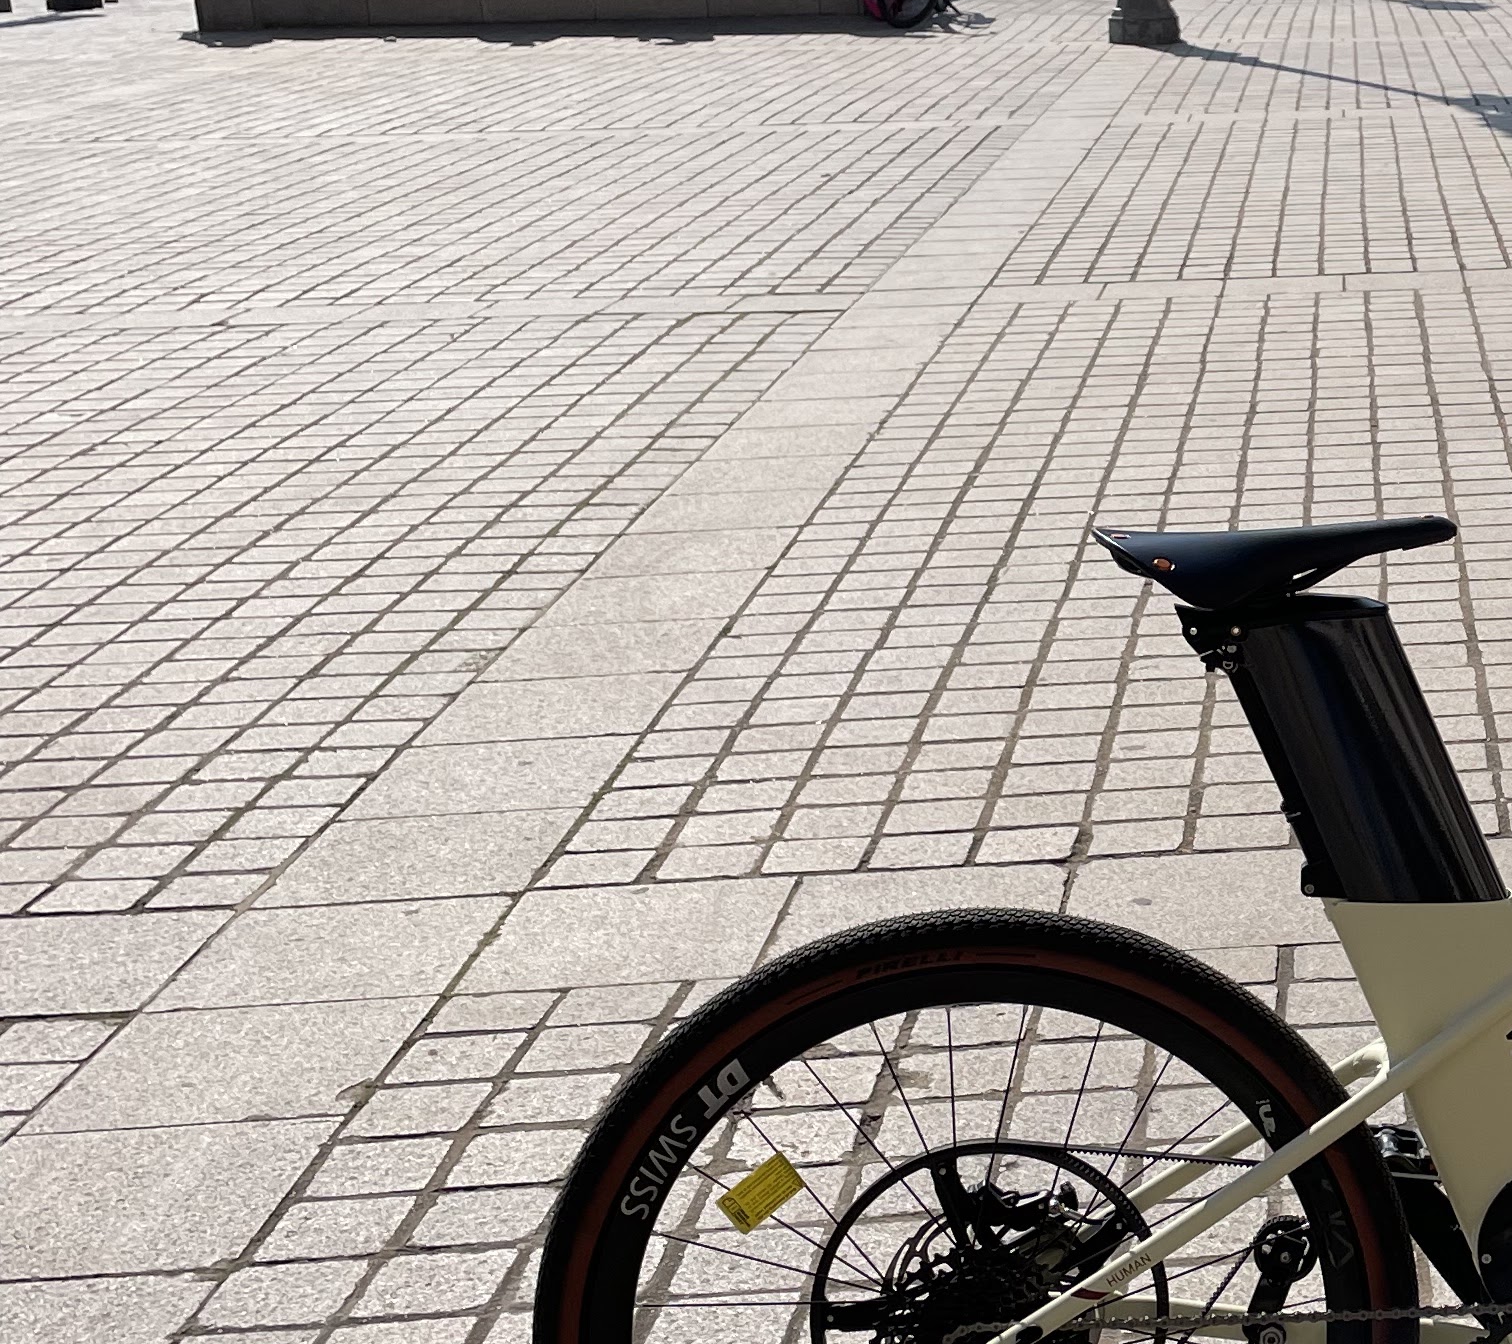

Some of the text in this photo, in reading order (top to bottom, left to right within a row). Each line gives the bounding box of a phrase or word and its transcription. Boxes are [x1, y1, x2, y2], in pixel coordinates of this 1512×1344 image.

[855, 951, 965, 980] PIRELLI
[620, 1058, 750, 1220] DT SWISS
[1105, 1251, 1152, 1288] HUMAN
